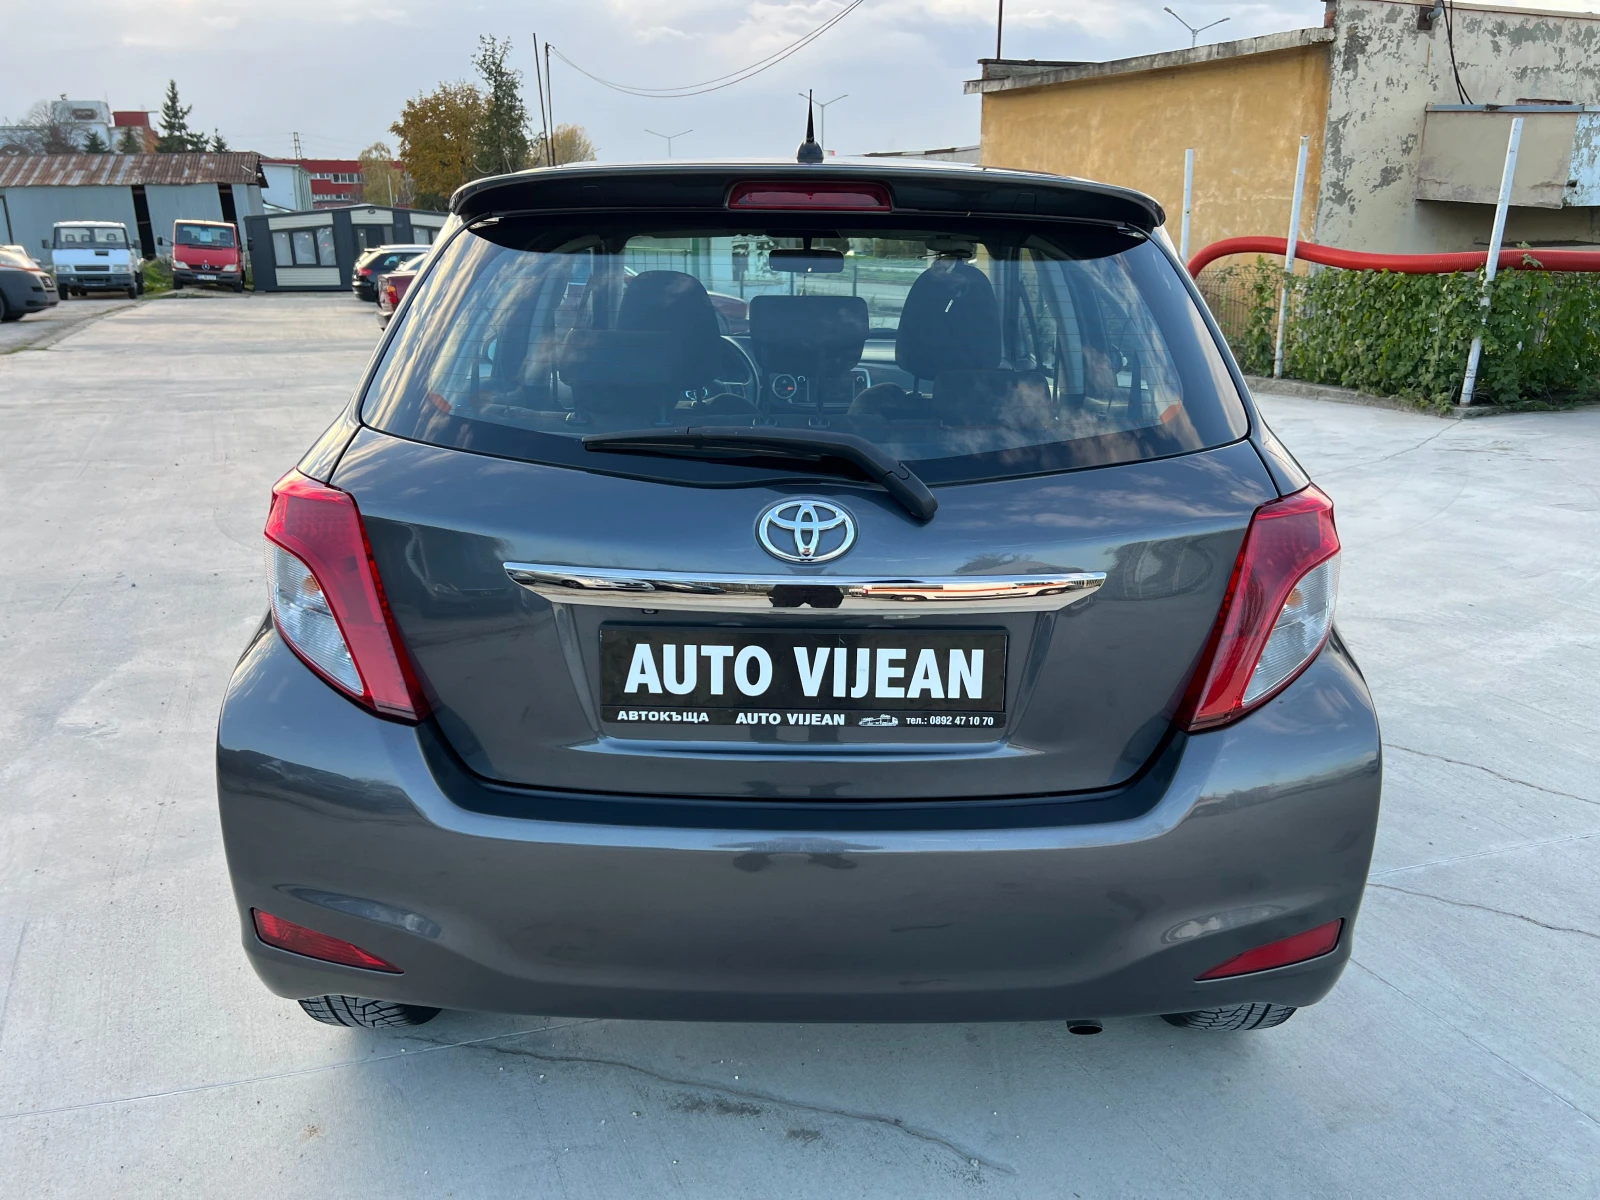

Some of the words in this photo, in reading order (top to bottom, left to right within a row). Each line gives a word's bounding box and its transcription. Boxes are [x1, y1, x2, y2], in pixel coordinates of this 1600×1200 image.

[624, 643, 773, 697] AUTO
[793, 646, 985, 699] VIJEAN
[616, 710, 710, 723] АВТОКЪЩА
[735, 712, 782, 725] AUTO
[786, 713, 846, 726] VIJEAN
[905, 717, 928, 726] тел.:
[929, 715, 953, 726] 0892
[954, 716, 967, 726] 47
[968, 716, 980, 726] 10
[982, 716, 994, 727] 70
